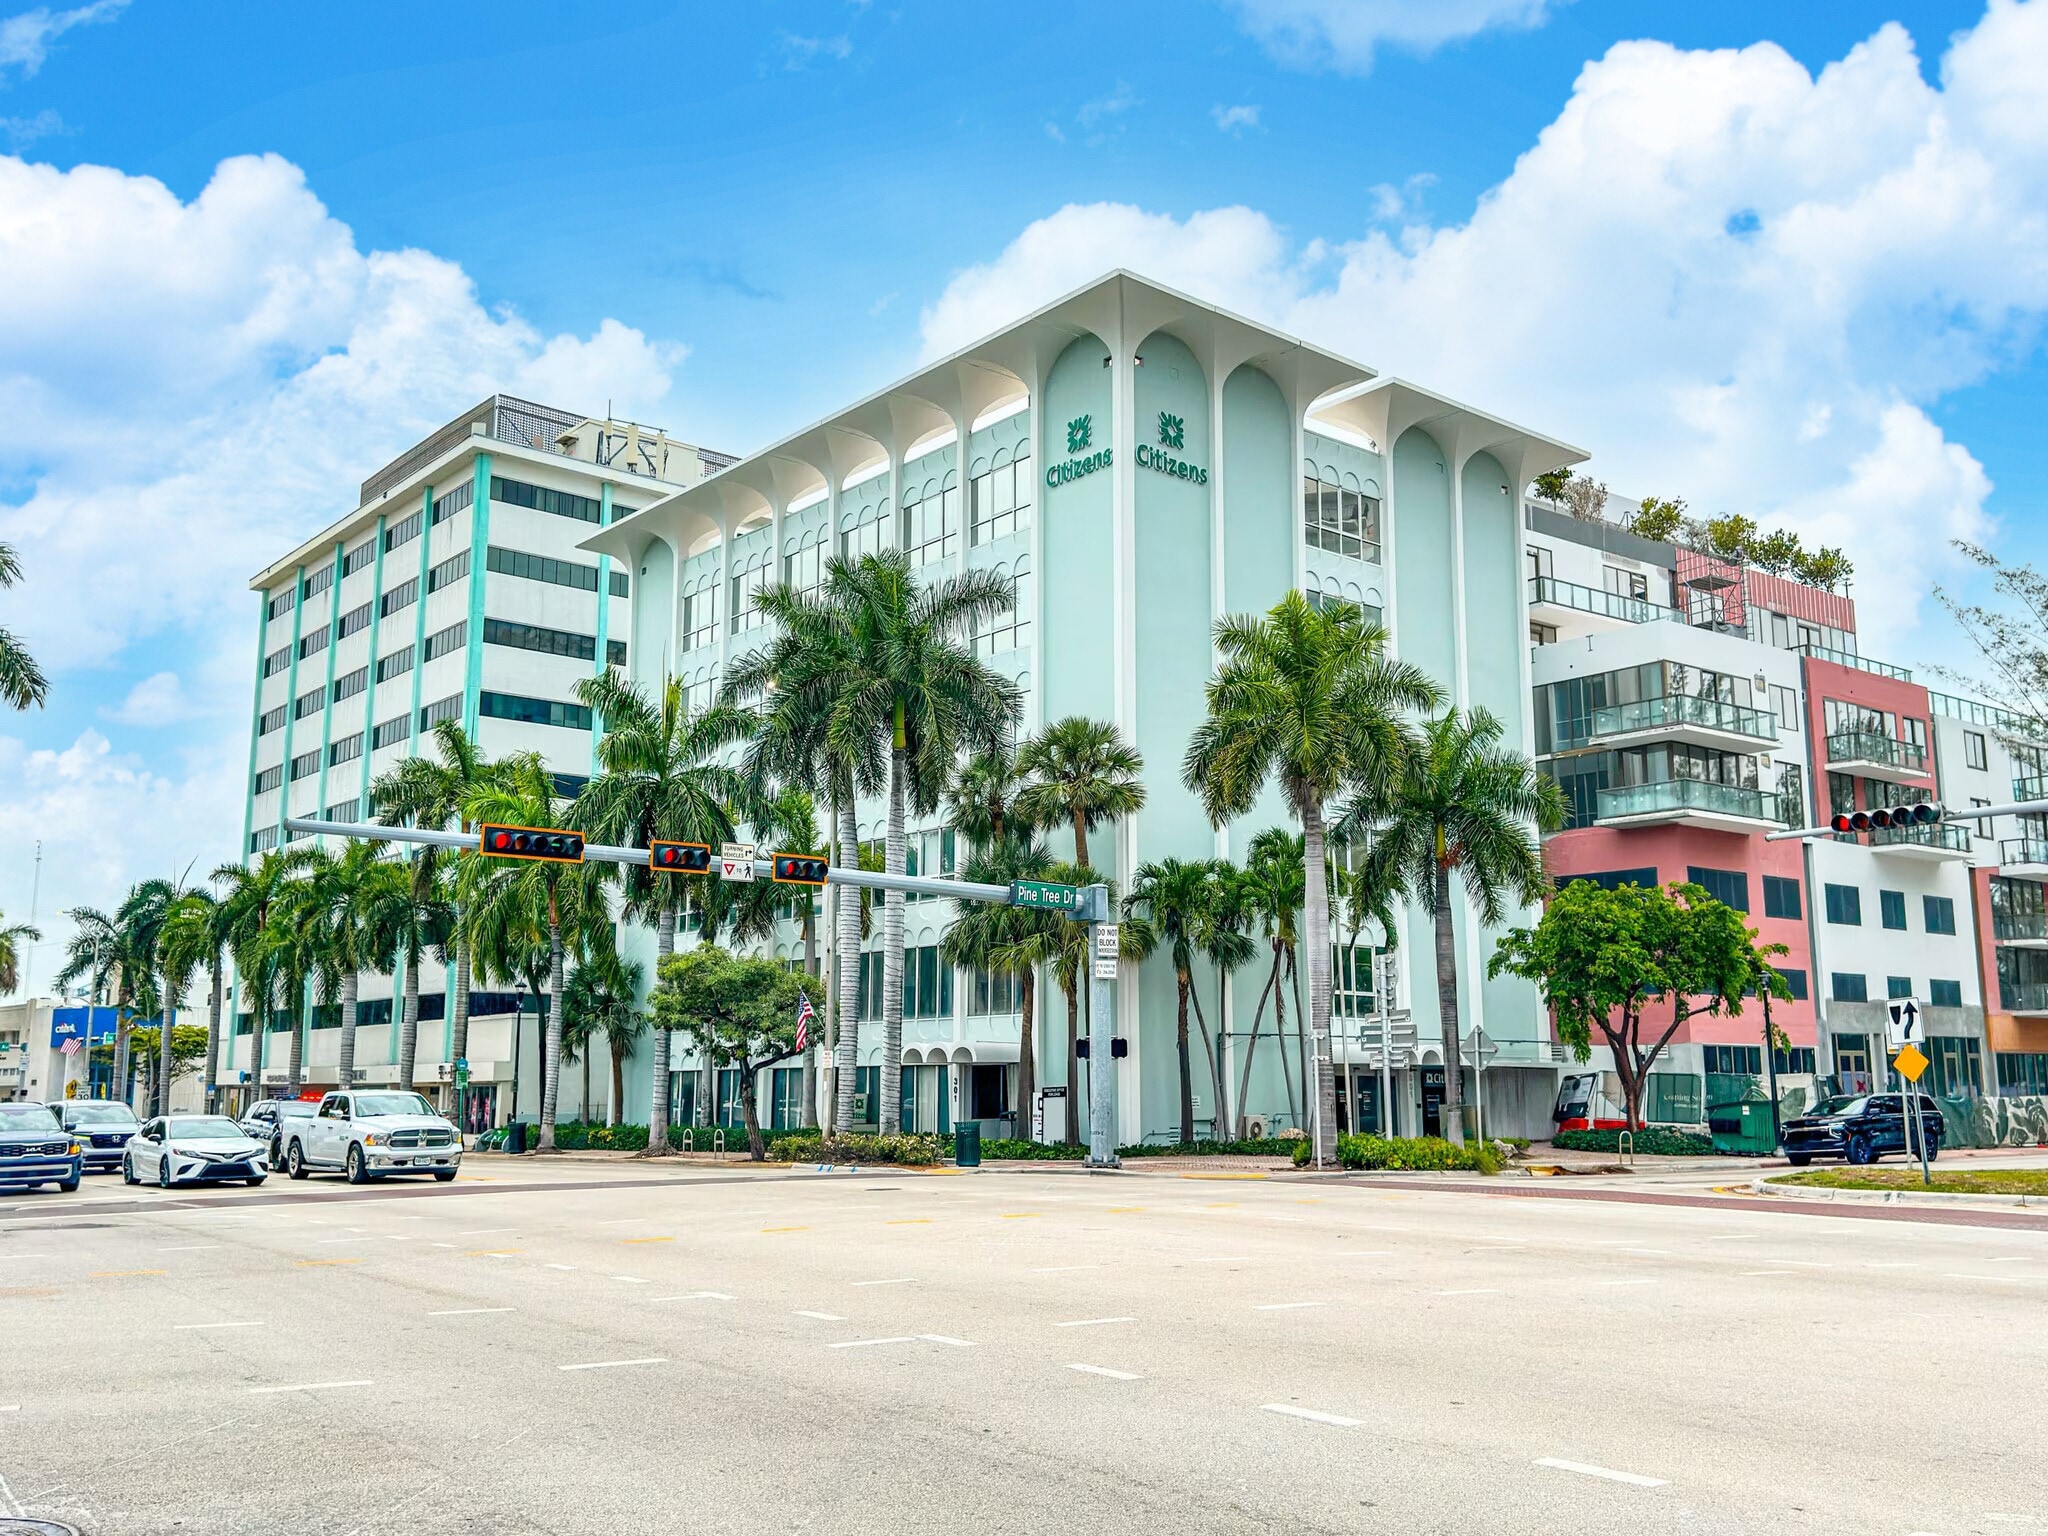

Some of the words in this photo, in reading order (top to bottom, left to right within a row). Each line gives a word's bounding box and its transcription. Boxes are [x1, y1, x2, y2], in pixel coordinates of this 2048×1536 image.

[1046, 448, 1113, 488] Citizens
[1135, 444, 1208, 485] Citizens
[1018, 886, 1037, 901] Pine
[1041, 888, 1060, 903] Tree
[1063, 890, 1074, 904] Dr
[1097, 928, 1105, 936] DO
[1106, 928, 1117, 937] NOT
[1098, 938, 1116, 947] BLOCK
[1663, 1094, 1690, 1103] Coming
